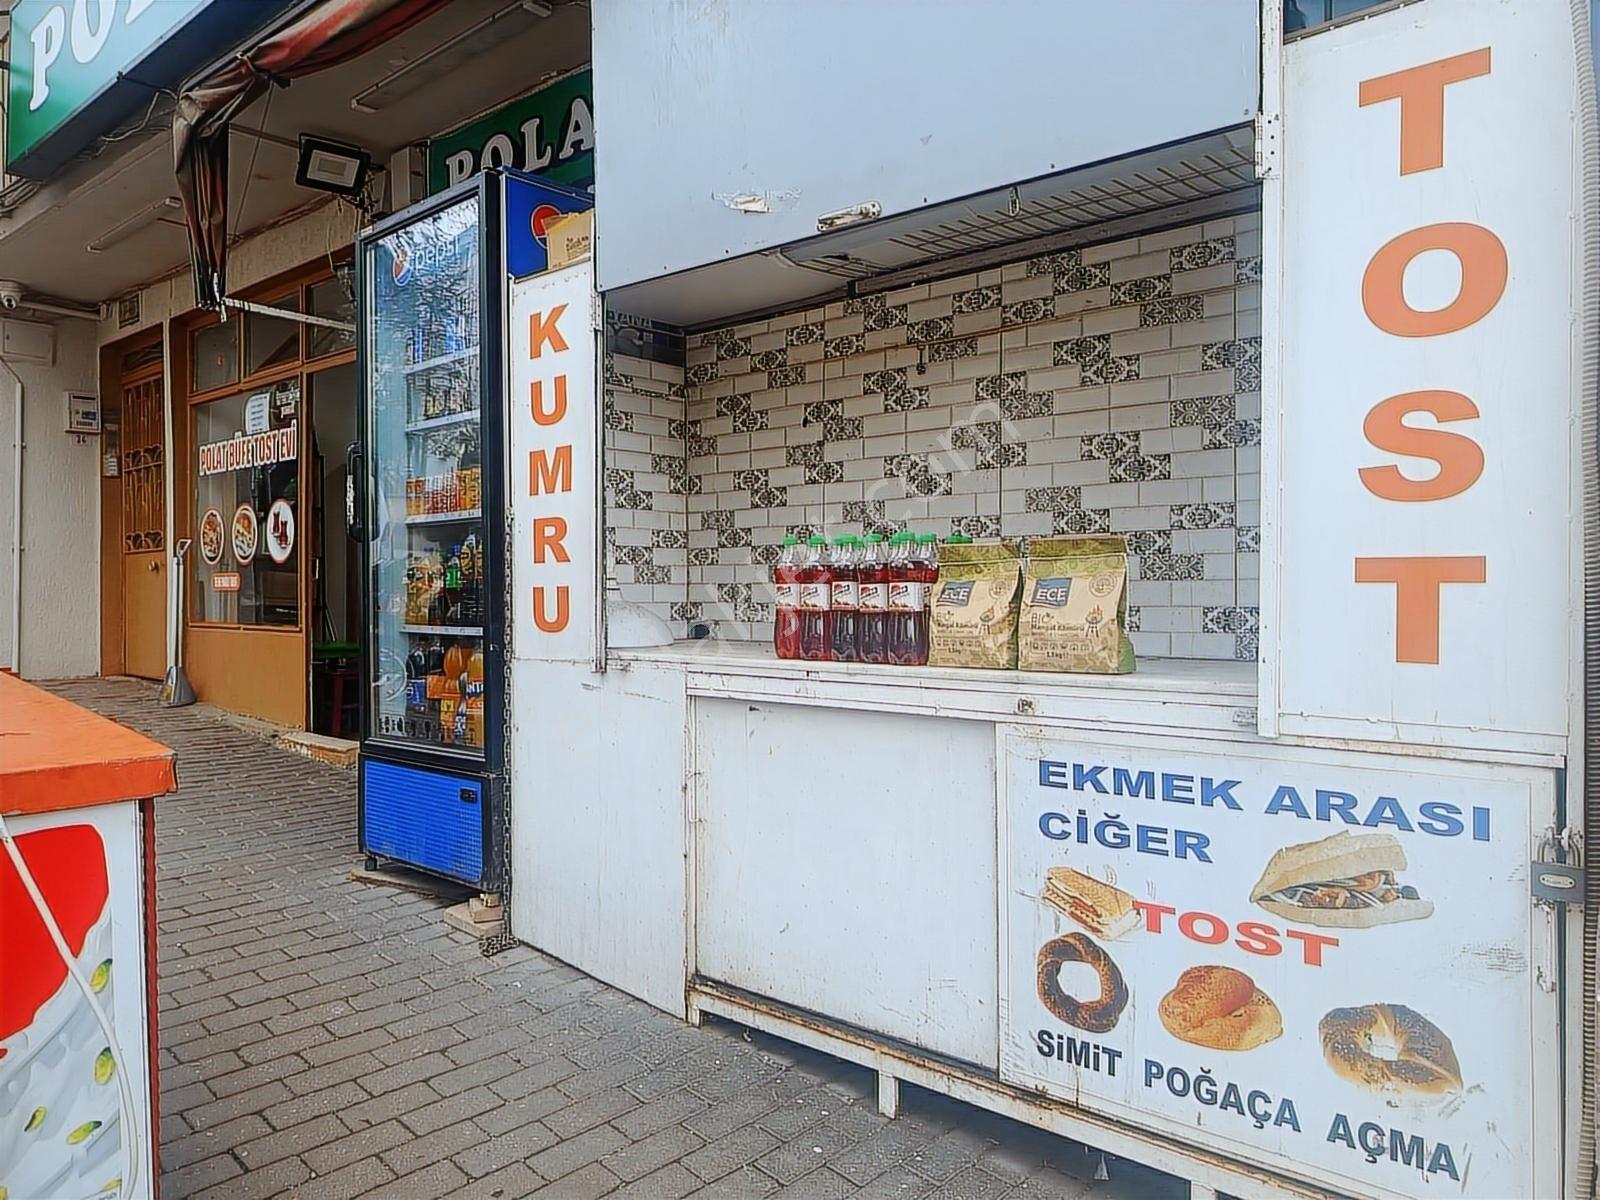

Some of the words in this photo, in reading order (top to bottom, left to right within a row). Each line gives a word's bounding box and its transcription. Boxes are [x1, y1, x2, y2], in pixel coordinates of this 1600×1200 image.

[29, 0, 156, 112] PO
[446, 97, 595, 188] POLA
[1354, 46, 1509, 665] TOST
[200, 441, 227, 475] POLAT
[253, 431, 278, 465] TOST
[529, 302, 573, 634] KUMRU
[1035, 587, 1068, 601] ECE
[1038, 759, 1244, 811] EKMEK
[1264, 785, 1490, 841] ARASI
[1038, 809, 1213, 863] CİĞER
[1131, 900, 1340, 967] TOST
[1144, 1058, 1302, 1132] POĞAÇA
[1326, 1113, 1461, 1181] AÇMA
